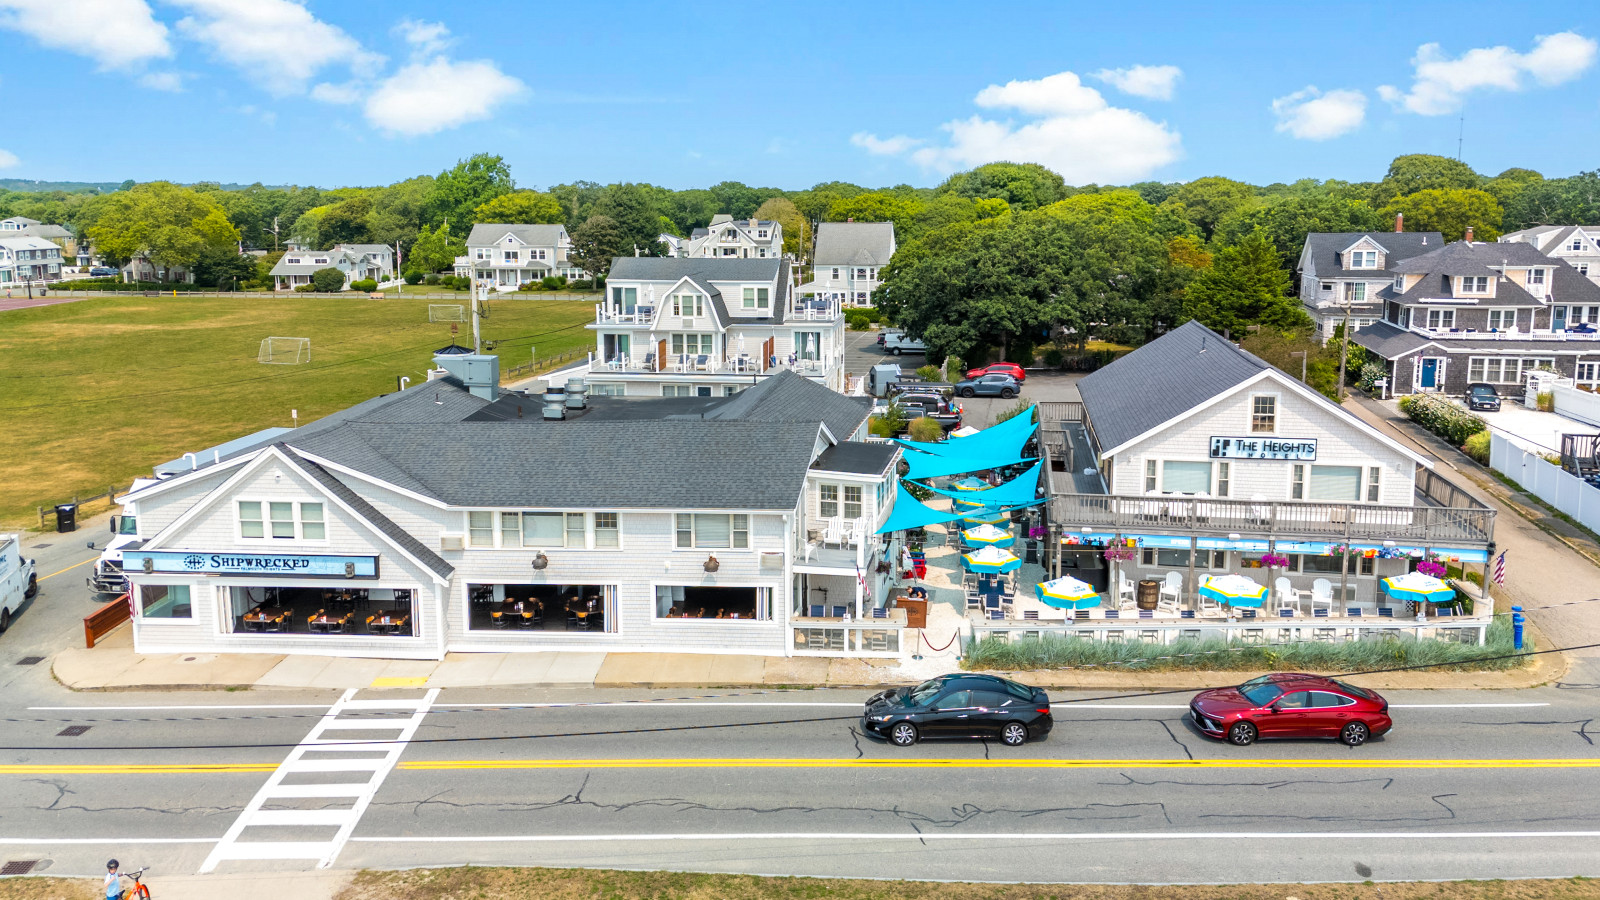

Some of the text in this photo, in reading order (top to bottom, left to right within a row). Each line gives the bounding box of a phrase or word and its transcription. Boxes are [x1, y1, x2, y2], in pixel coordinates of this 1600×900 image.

[1236, 439, 1315, 453] THE HEIGHTS
[210, 555, 310, 569] SHIPWRECKED
